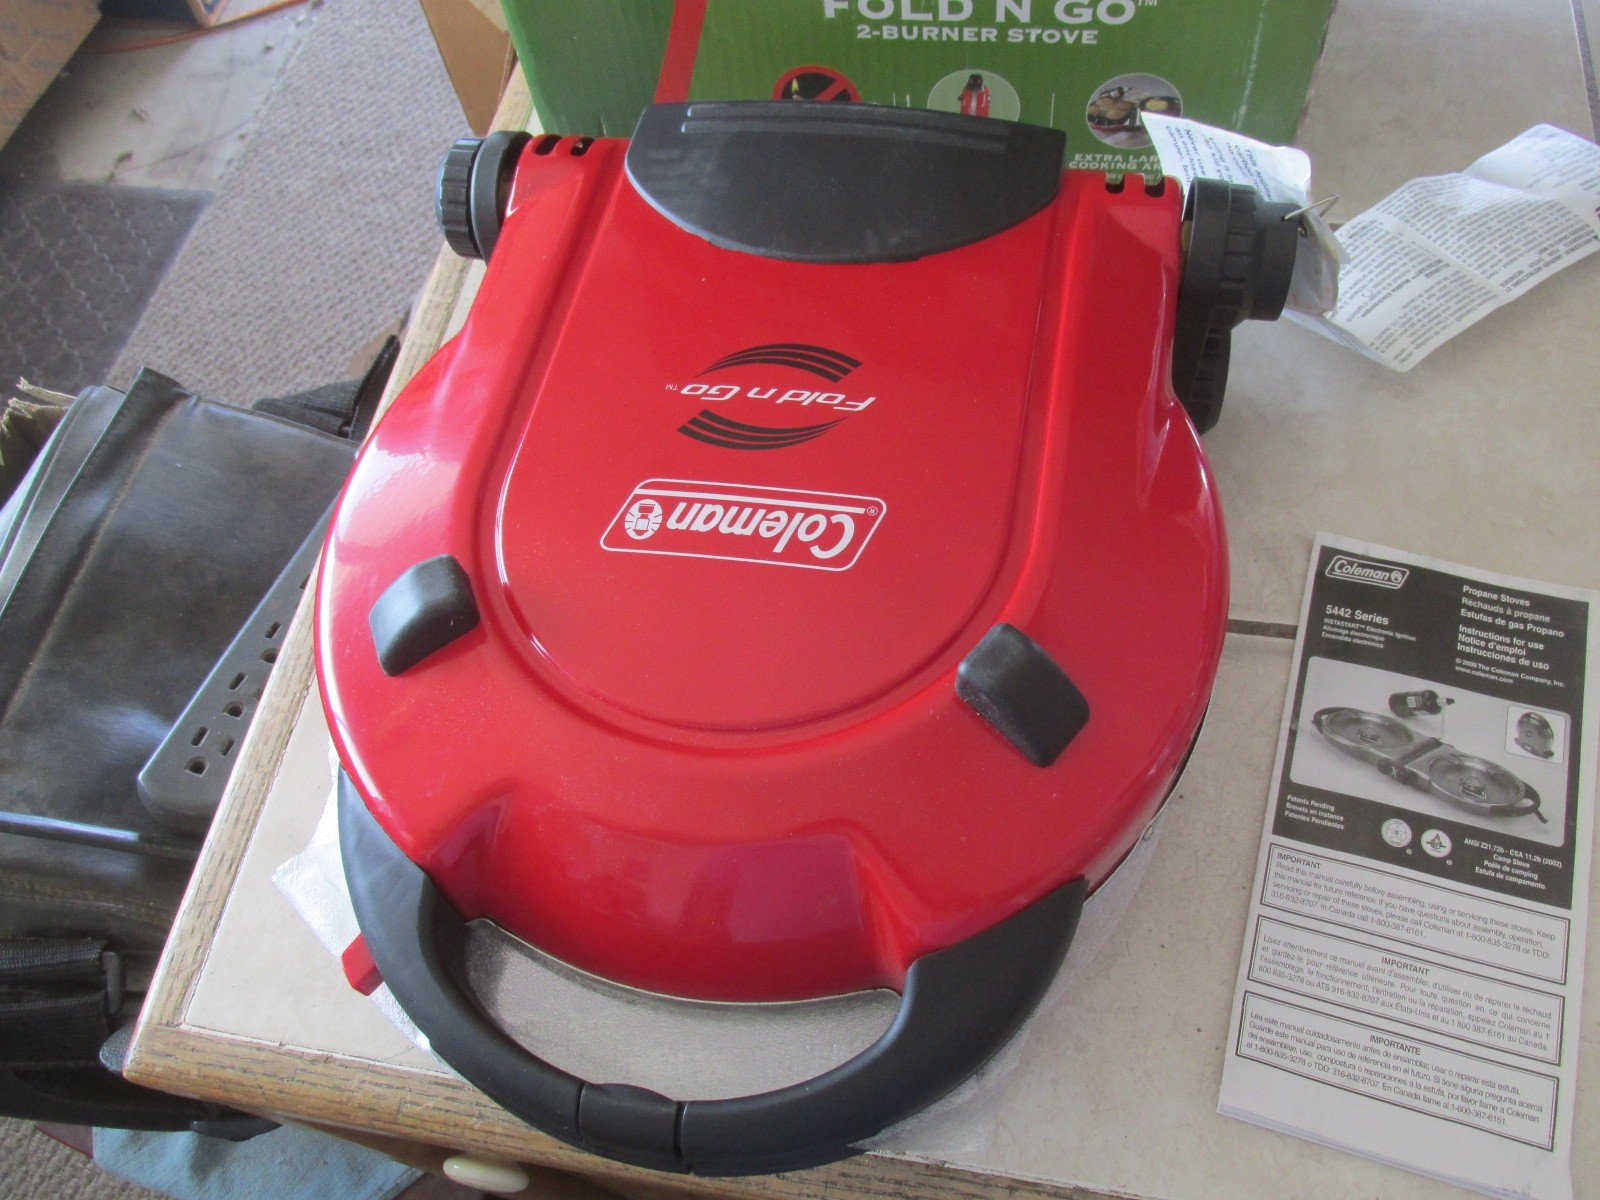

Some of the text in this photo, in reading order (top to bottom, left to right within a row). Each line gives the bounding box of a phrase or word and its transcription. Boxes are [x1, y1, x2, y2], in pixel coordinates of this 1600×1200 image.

[995, 0, 1031, 23] N
[856, 24, 1098, 45] 2-BURNER STOVE
[1175, 126, 1183, 139] an
[1074, 153, 1123, 162] EXTRA
[1184, 128, 1199, 155] Never
[1196, 157, 1207, 176] use
[1068, 161, 1138, 170] COOKING
[680, 383, 741, 400] Go
[746, 386, 778, 398] n
[775, 389, 876, 411] Fold
[666, 501, 855, 559] Coleman
[1333, 558, 1390, 582] Coleman
[1462, 584, 1530, 607] Propane Stoves
[1325, 603, 1389, 626] 5442 Series
[1461, 596, 1550, 625] Réchauds à propane
[1460, 608, 1564, 639] Estufas de gas Propano
[1457, 633, 1526, 657] Notice d'emploi
[1458, 624, 1544, 650] Instructions for use
[1456, 642, 1549, 670] Instrucciones de uso
[1454, 665, 1513, 684] www.coleman.com
[1477, 663, 1489, 671] The
[1491, 666, 1518, 678] Coleman
[1520, 672, 1552, 686] Company,
[1553, 679, 1565, 687] Inc.
[1286, 794, 1335, 812] Patents Pending
[1284, 809, 1344, 830] Patentes Pendientes
[1318, 810, 1343, 822] instance
[1277, 852, 1321, 870] IMPORTANT
[1463, 837, 1479, 847] ANSI
[1509, 849, 1522, 858] CSA
[1542, 857, 1561, 869] (2002)
[1493, 853, 1530, 868] Camp Stove
[1475, 866, 1545, 890] Estufa de campamento
[1501, 864, 1537, 880] de camping
[1272, 880, 1303, 895] servicing
[1311, 890, 1331, 903] repair
[1340, 898, 1360, 909] these
[1385, 909, 1409, 924] please
[1423, 919, 1455, 934] Coleman
[1275, 861, 1555, 942] Read manual carefully before assembling, using servicing these Keep
[1287, 874, 1507, 940] manual future have questions about assembly,
[1381, 956, 1429, 976] IMPORTANT
[1369, 1033, 1420, 1056] IMPORTANTE
